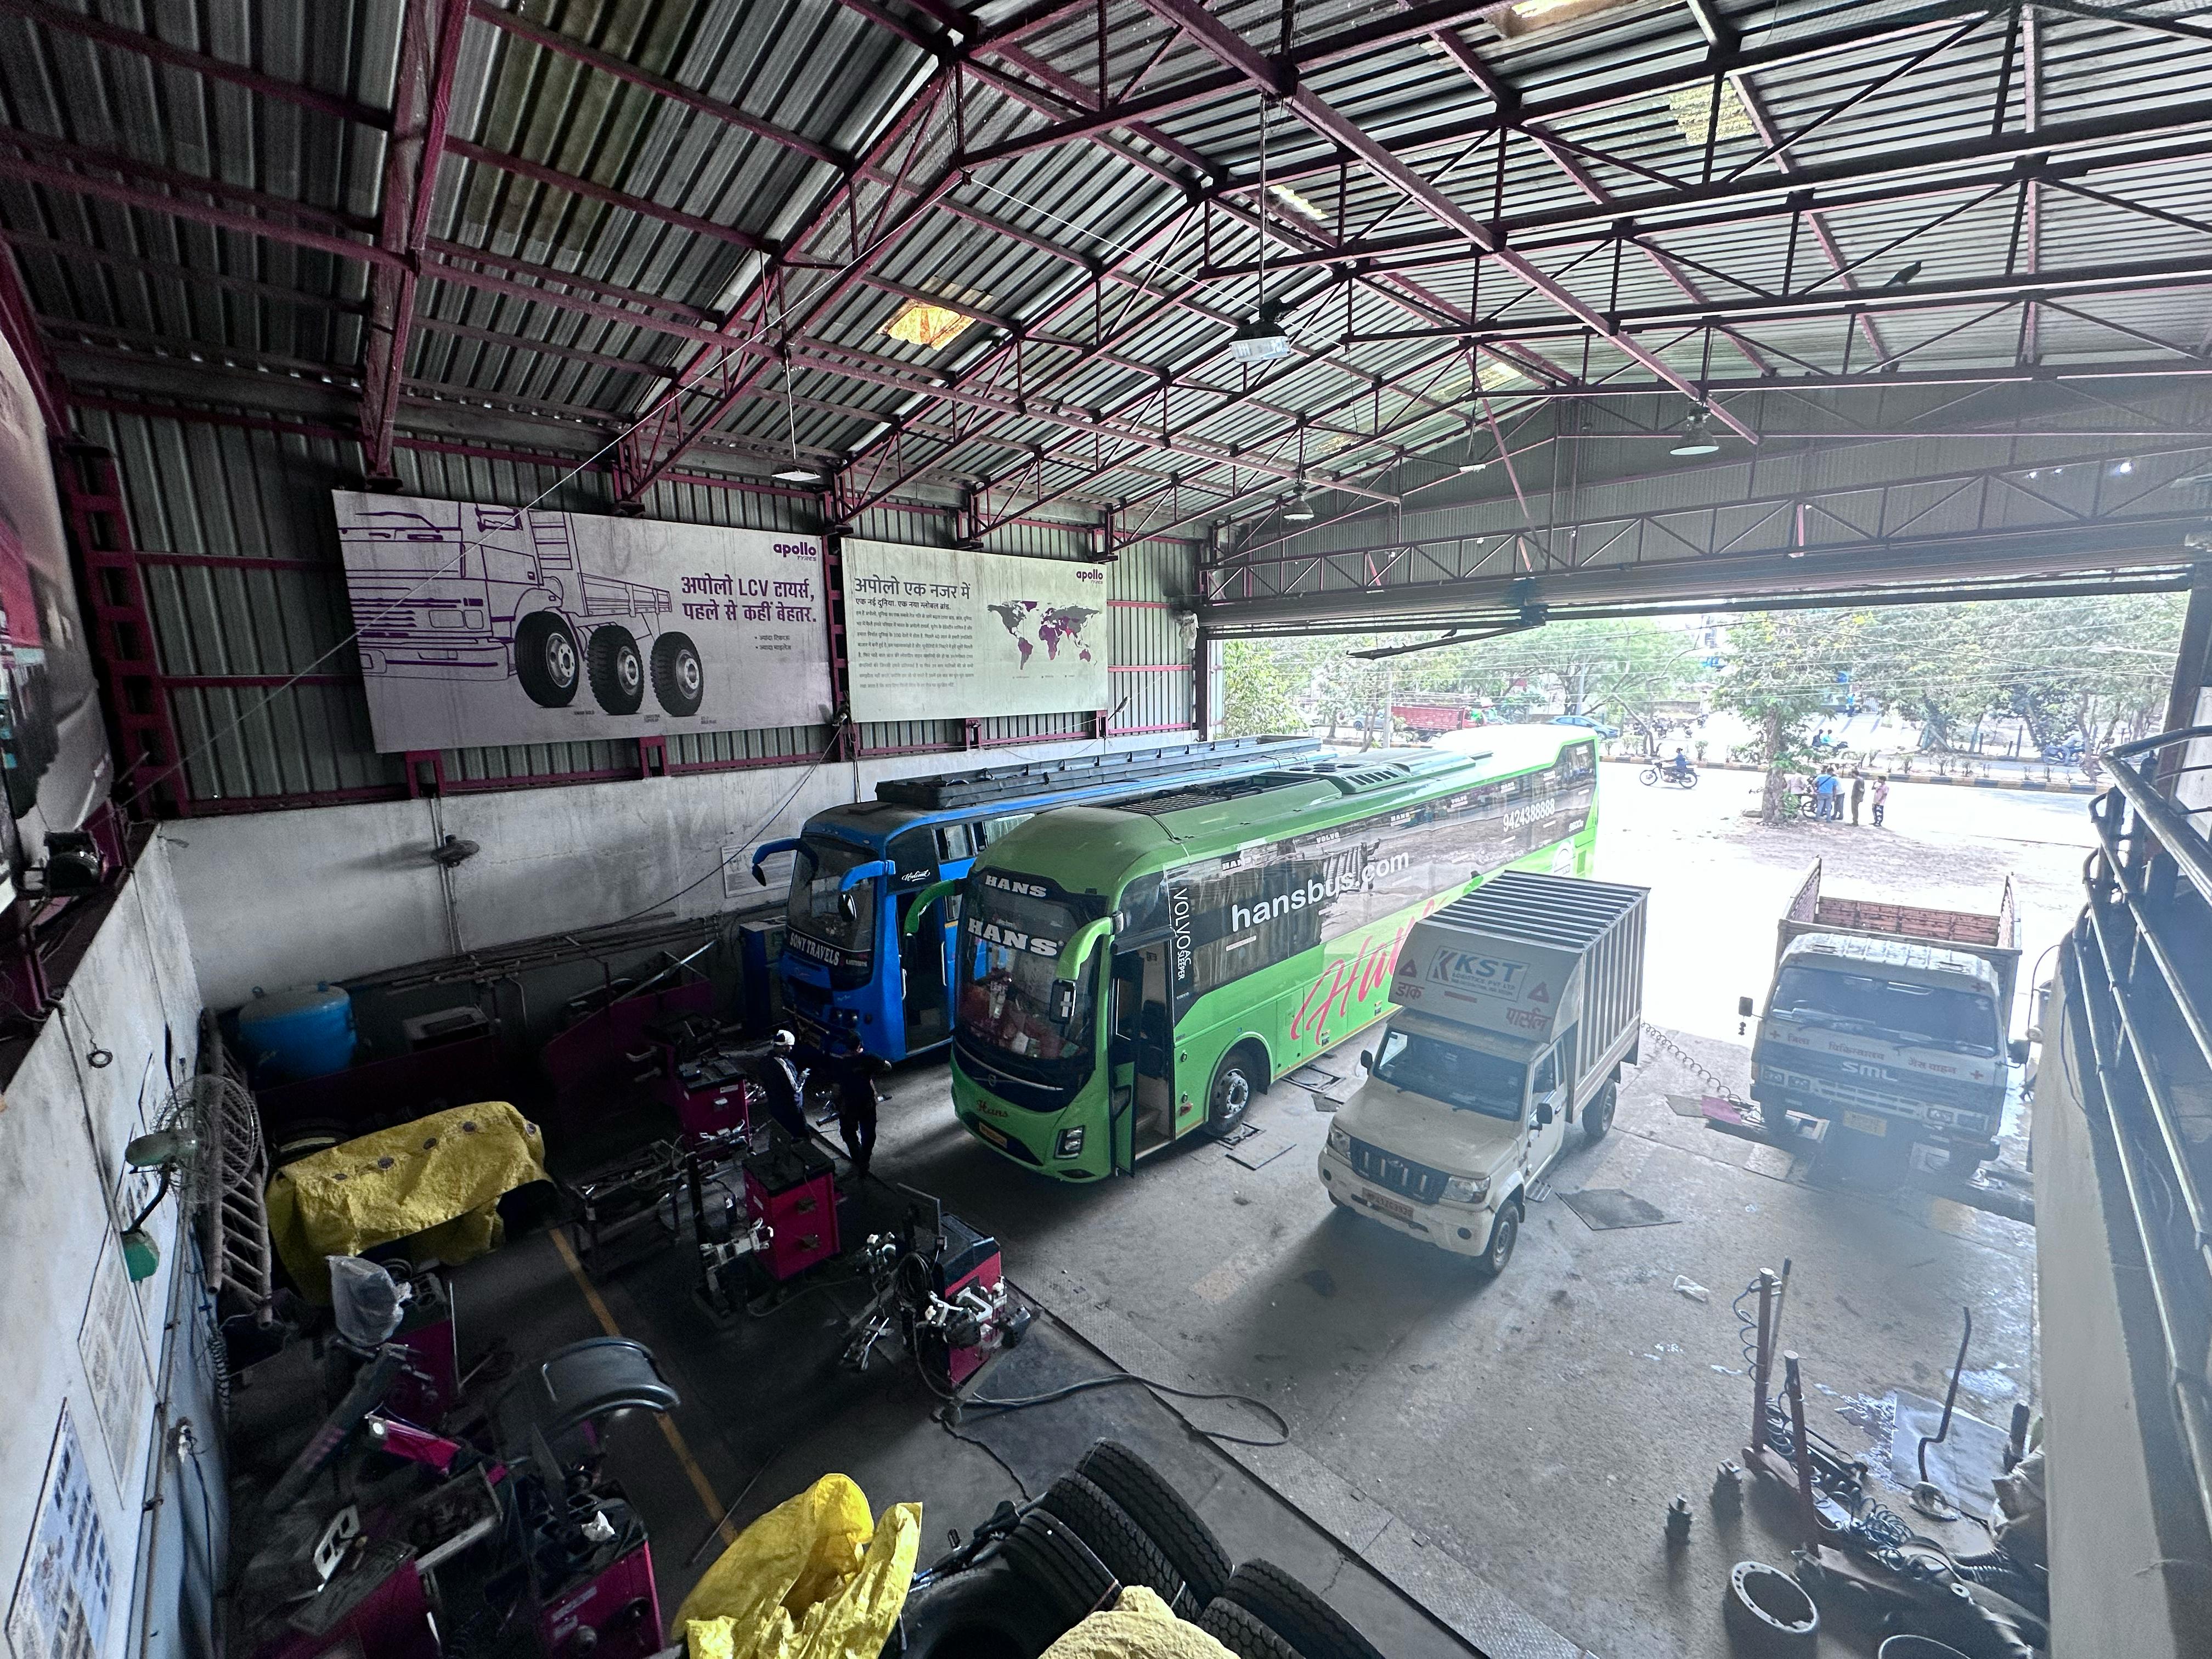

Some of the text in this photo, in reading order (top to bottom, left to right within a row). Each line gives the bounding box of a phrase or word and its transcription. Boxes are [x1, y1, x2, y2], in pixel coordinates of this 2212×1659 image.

[774, 541, 816, 557] apollo
[855, 574, 970, 599] अपोलो एक नजर में
[1076, 569, 1103, 582] apollo
[681, 573, 814, 602] अपोलो LCV टायर्स,
[682, 599, 816, 622] पहले से कहीं बेहतर.
[868, 597, 876, 606] नई
[1451, 795, 1467, 804] VOLVO
[1390, 812, 1410, 822] HANS
[1503, 798, 1555, 832] 9424388888
[1317, 832, 1340, 843] VOLVO
[985, 874, 1047, 897] HANS
[1232, 851, 1409, 932] hansbus.com
[1173, 888, 1191, 950] VOLVO
[968, 917, 1057, 956] HANS
[790, 932, 839, 966] SONY TRAVELS
[1184, 950, 1192, 965] AC
[1454, 953, 1523, 983] KST
[1395, 981, 1424, 1000] डाक
[1506, 1007, 1551, 1031] पार्सल
[977, 1099, 1008, 1118] Hans
